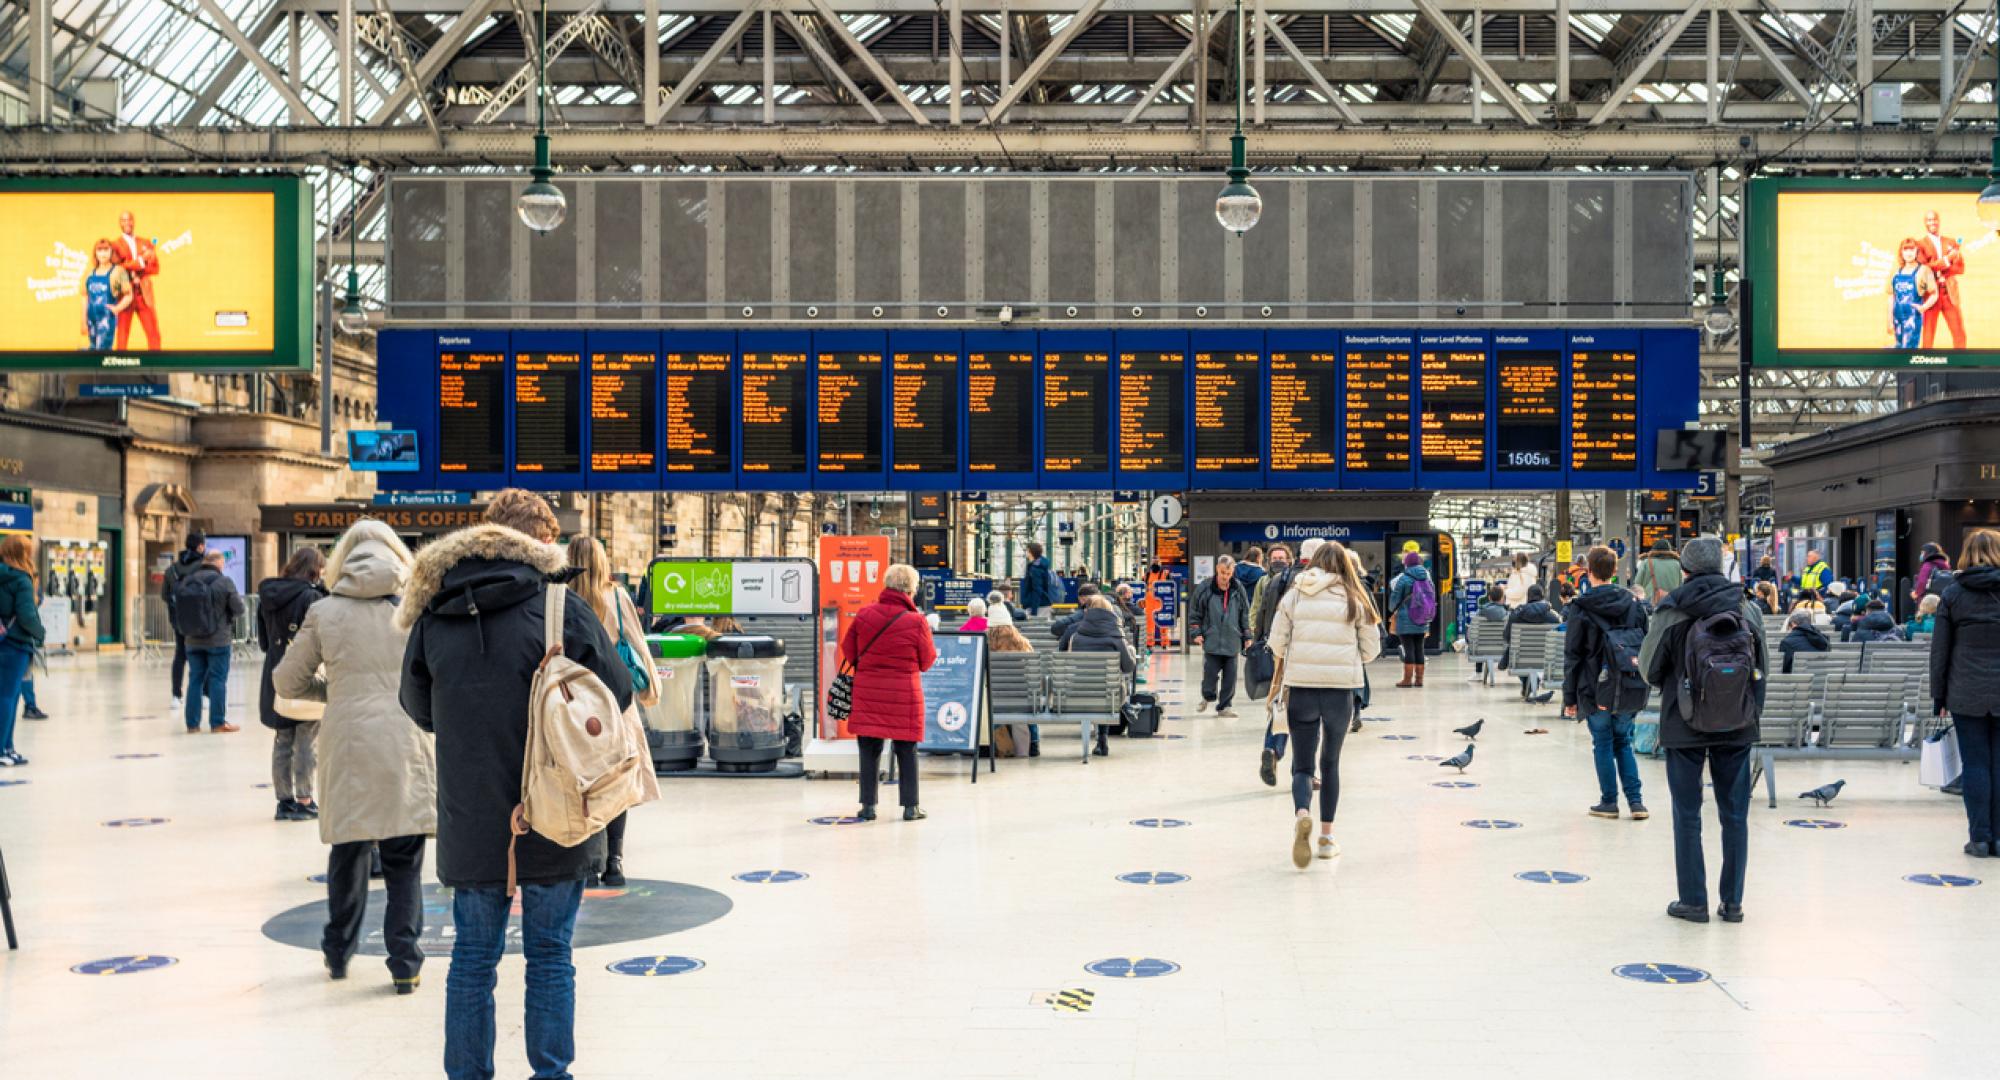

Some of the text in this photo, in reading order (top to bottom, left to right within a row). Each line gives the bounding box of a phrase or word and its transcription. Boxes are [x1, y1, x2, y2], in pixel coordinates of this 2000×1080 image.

[1345, 336, 1411, 345] Subsequent Departures
[1421, 336, 1483, 344] Lower Level Platforms
[1496, 336, 1528, 344] Information
[1572, 336, 1594, 344] Arrivals
[1509, 453, 1540, 464] 1505
[1698, 475, 1709, 493] 5
[400, 495, 435, 504] Platforms
[1283, 525, 1349, 537] Information
[741, 577, 763, 585] general
[925, 582, 935, 600] 3
[665, 602, 675, 610] dry
[694, 602, 720, 610] recycling
[947, 655, 968, 665] safer
